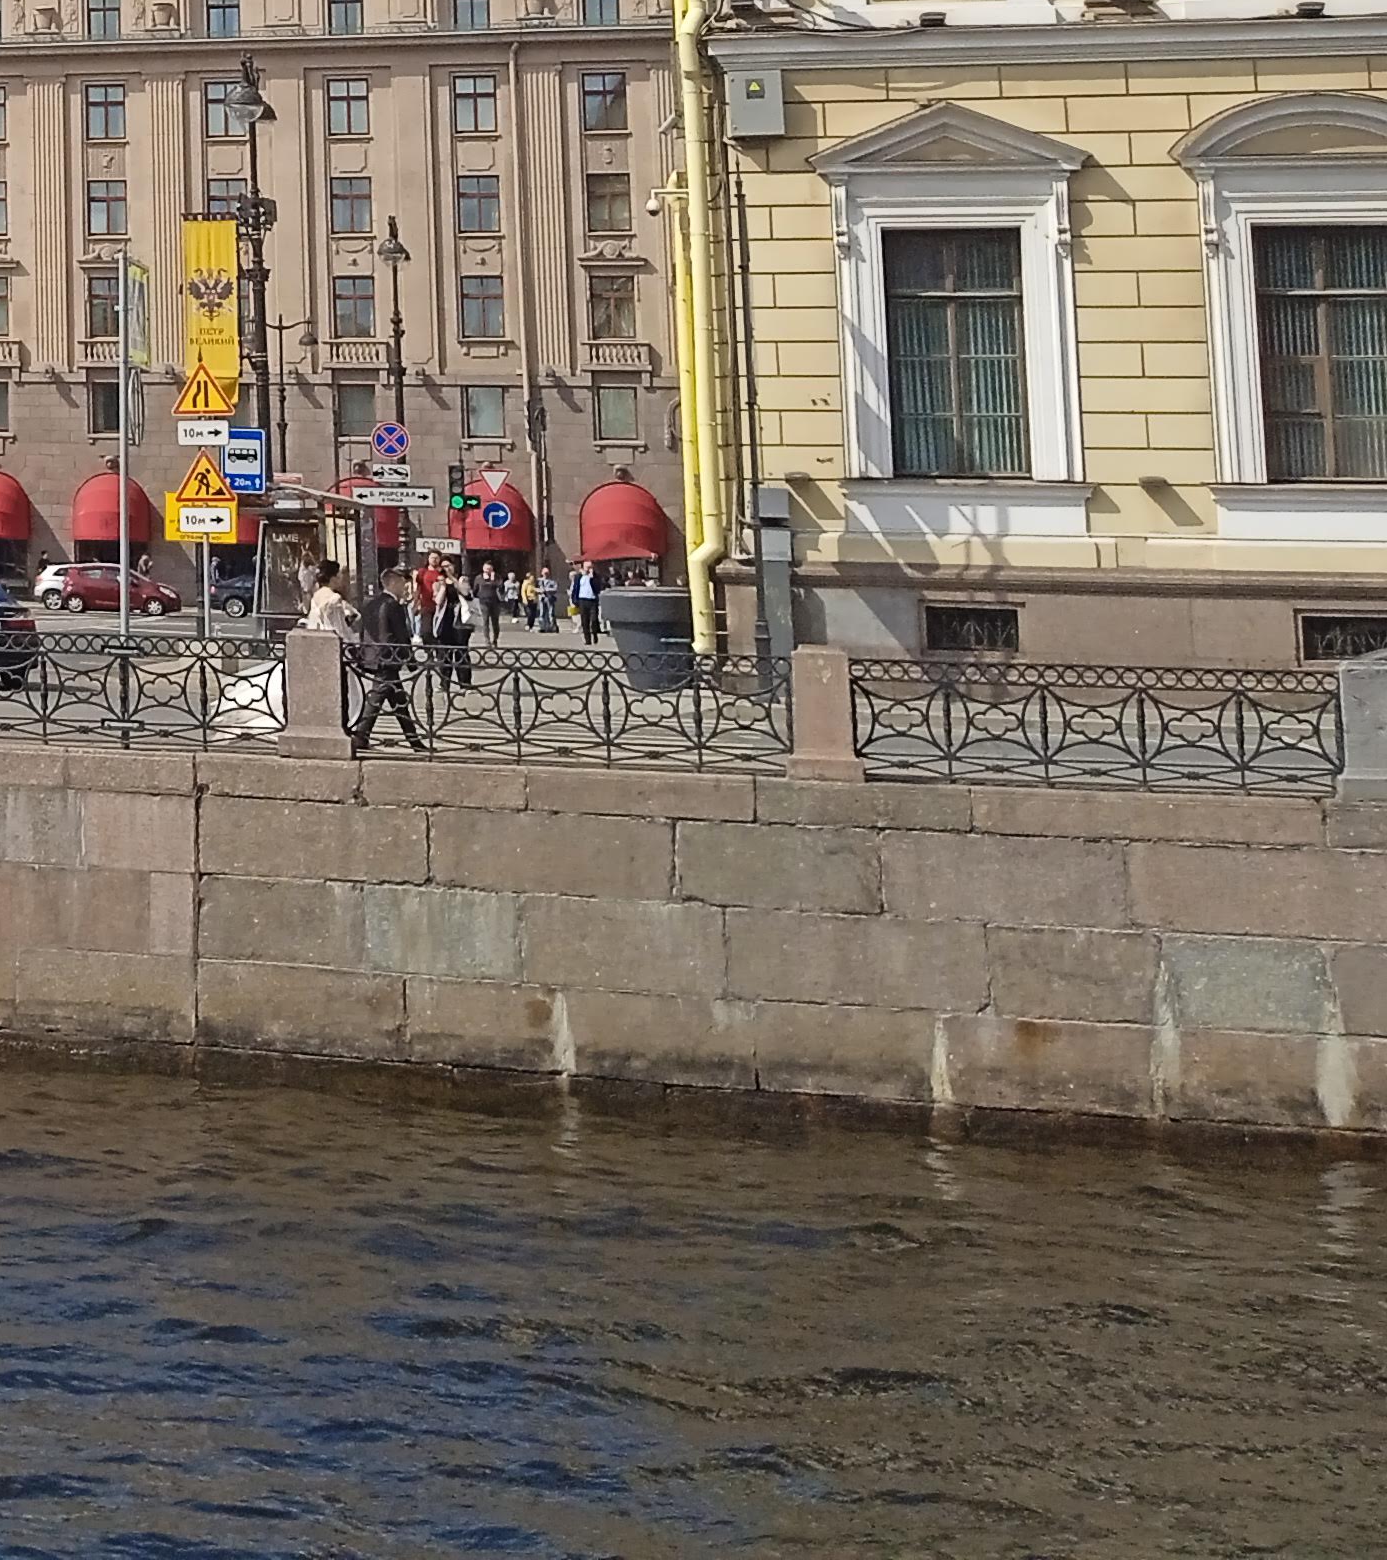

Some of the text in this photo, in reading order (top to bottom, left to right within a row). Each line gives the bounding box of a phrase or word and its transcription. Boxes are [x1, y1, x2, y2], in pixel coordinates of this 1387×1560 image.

[183, 428, 204, 438] 10м
[185, 515, 206, 525] 10м
[422, 540, 455, 551] СТОП
